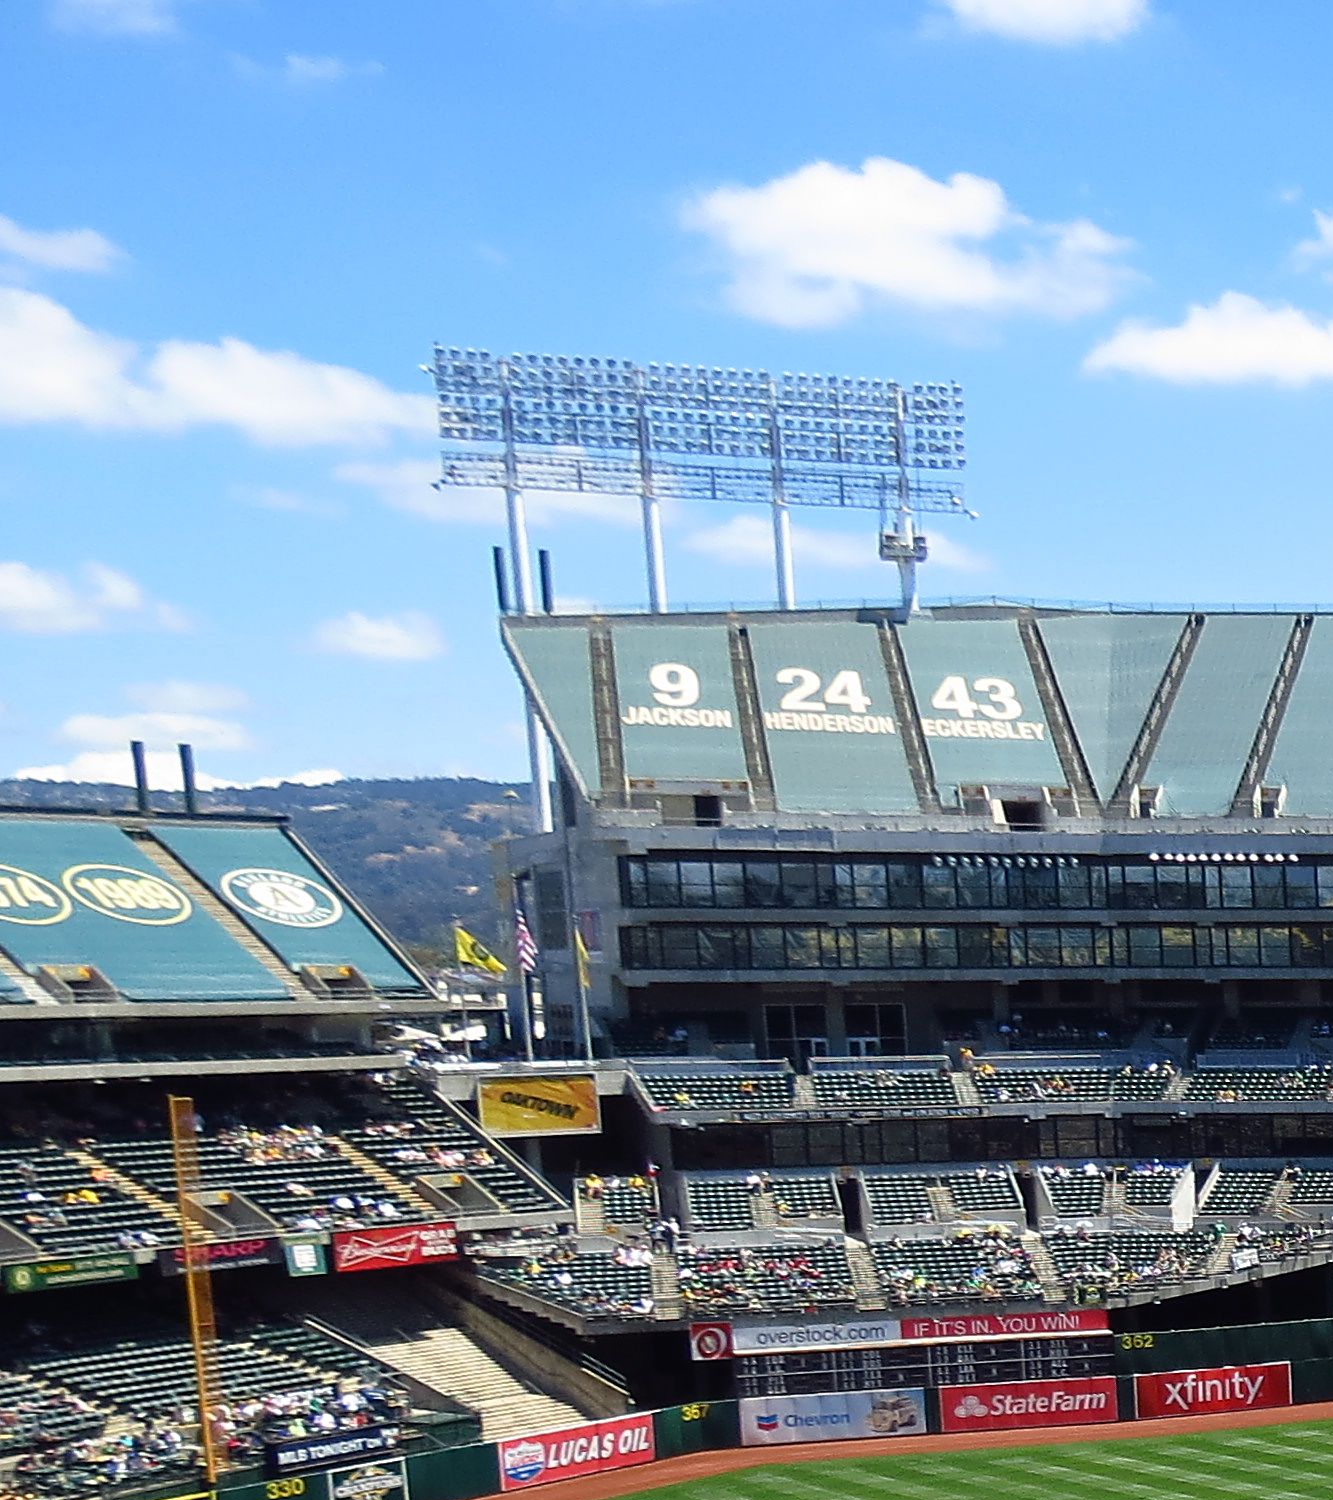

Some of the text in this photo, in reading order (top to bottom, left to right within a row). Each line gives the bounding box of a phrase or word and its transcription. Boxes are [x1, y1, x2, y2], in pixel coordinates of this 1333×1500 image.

[648, 663, 700, 706] 9
[775, 668, 871, 713] 24
[931, 676, 1022, 719] 43
[621, 706, 732, 728] JACKSON
[764, 711, 895, 734] HENDERSON
[922, 719, 1046, 741] ECKERSLEY
[76, 877, 181, 910] 1989
[756, 1325, 886, 1346] overstock.com
[914, 1313, 1080, 1337] IF IT'S IN. YOU WIN!
[1121, 1333, 1155, 1351] 362
[1165, 1372, 1265, 1411] xfinity
[681, 1404, 710, 1422] 367
[784, 1412, 850, 1428] Chevron
[278, 1449, 309, 1466] MLB
[308, 1438, 366, 1459] TONIGHT
[547, 1426, 650, 1469] LUCAS OIL
[266, 1478, 305, 1500] 330
